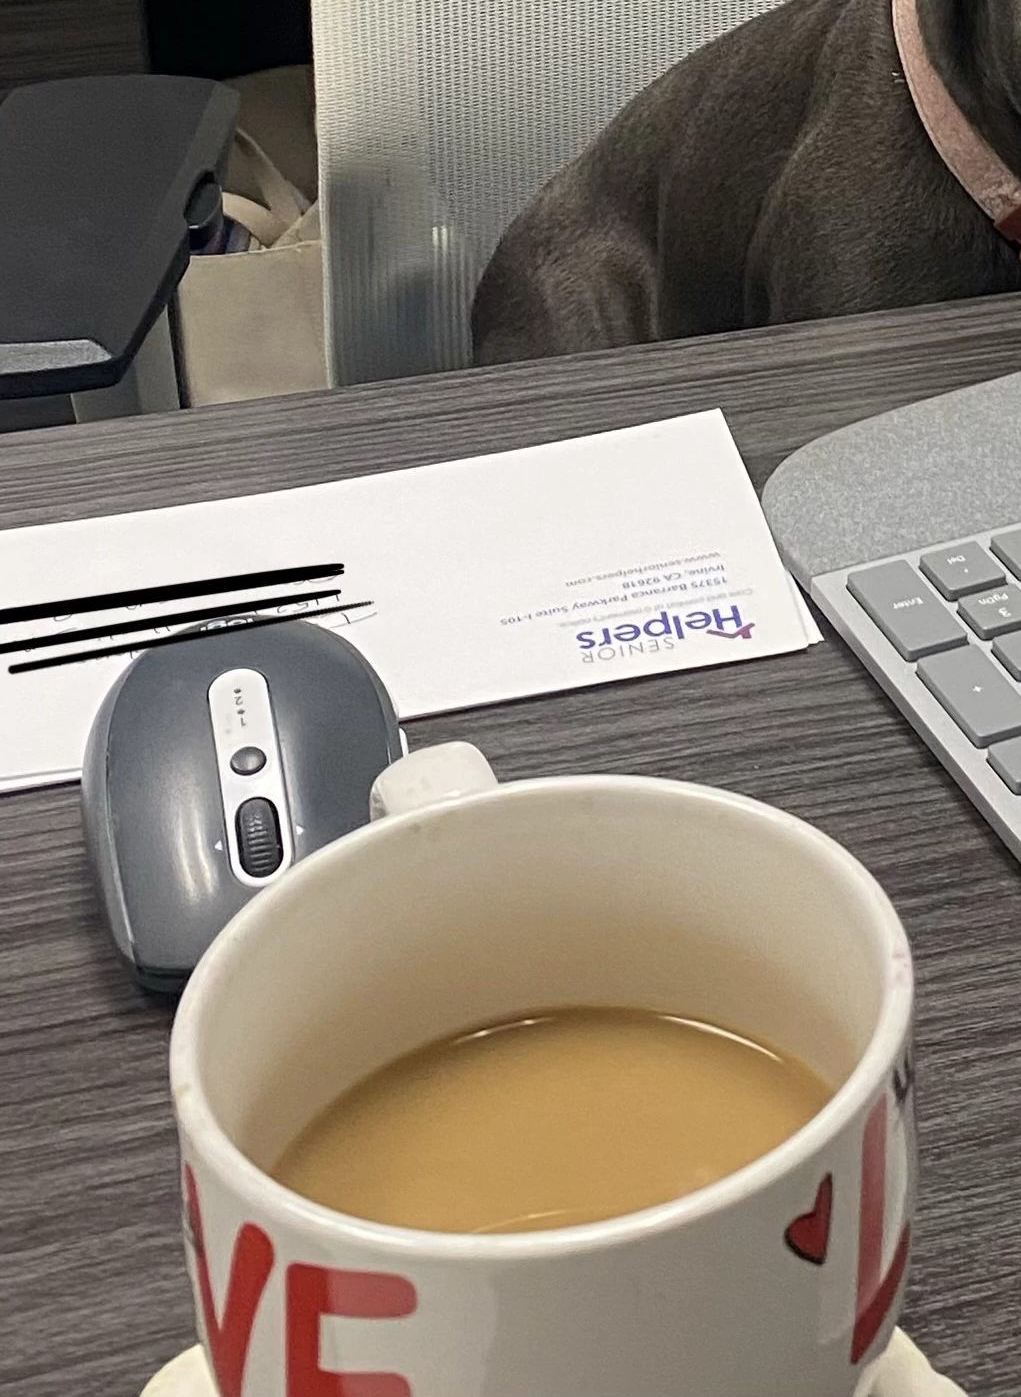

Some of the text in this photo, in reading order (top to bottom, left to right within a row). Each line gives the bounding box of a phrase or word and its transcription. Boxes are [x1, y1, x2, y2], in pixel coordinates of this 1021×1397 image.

[565, 552, 720, 587] www.seniorhelpers.com
[622, 564, 725, 589] Irvine, CA 92618
[691, 576, 727, 588] 15375
[631, 583, 687, 599] Barranca
[978, 592, 1008, 605] PgDn
[572, 594, 628, 611] Parkway
[893, 597, 923, 609] Enter
[535, 606, 568, 617] Suite
[999, 607, 1011, 617] 3
[576, 605, 743, 649] Helpers
[581, 636, 675, 663] SENIOR
